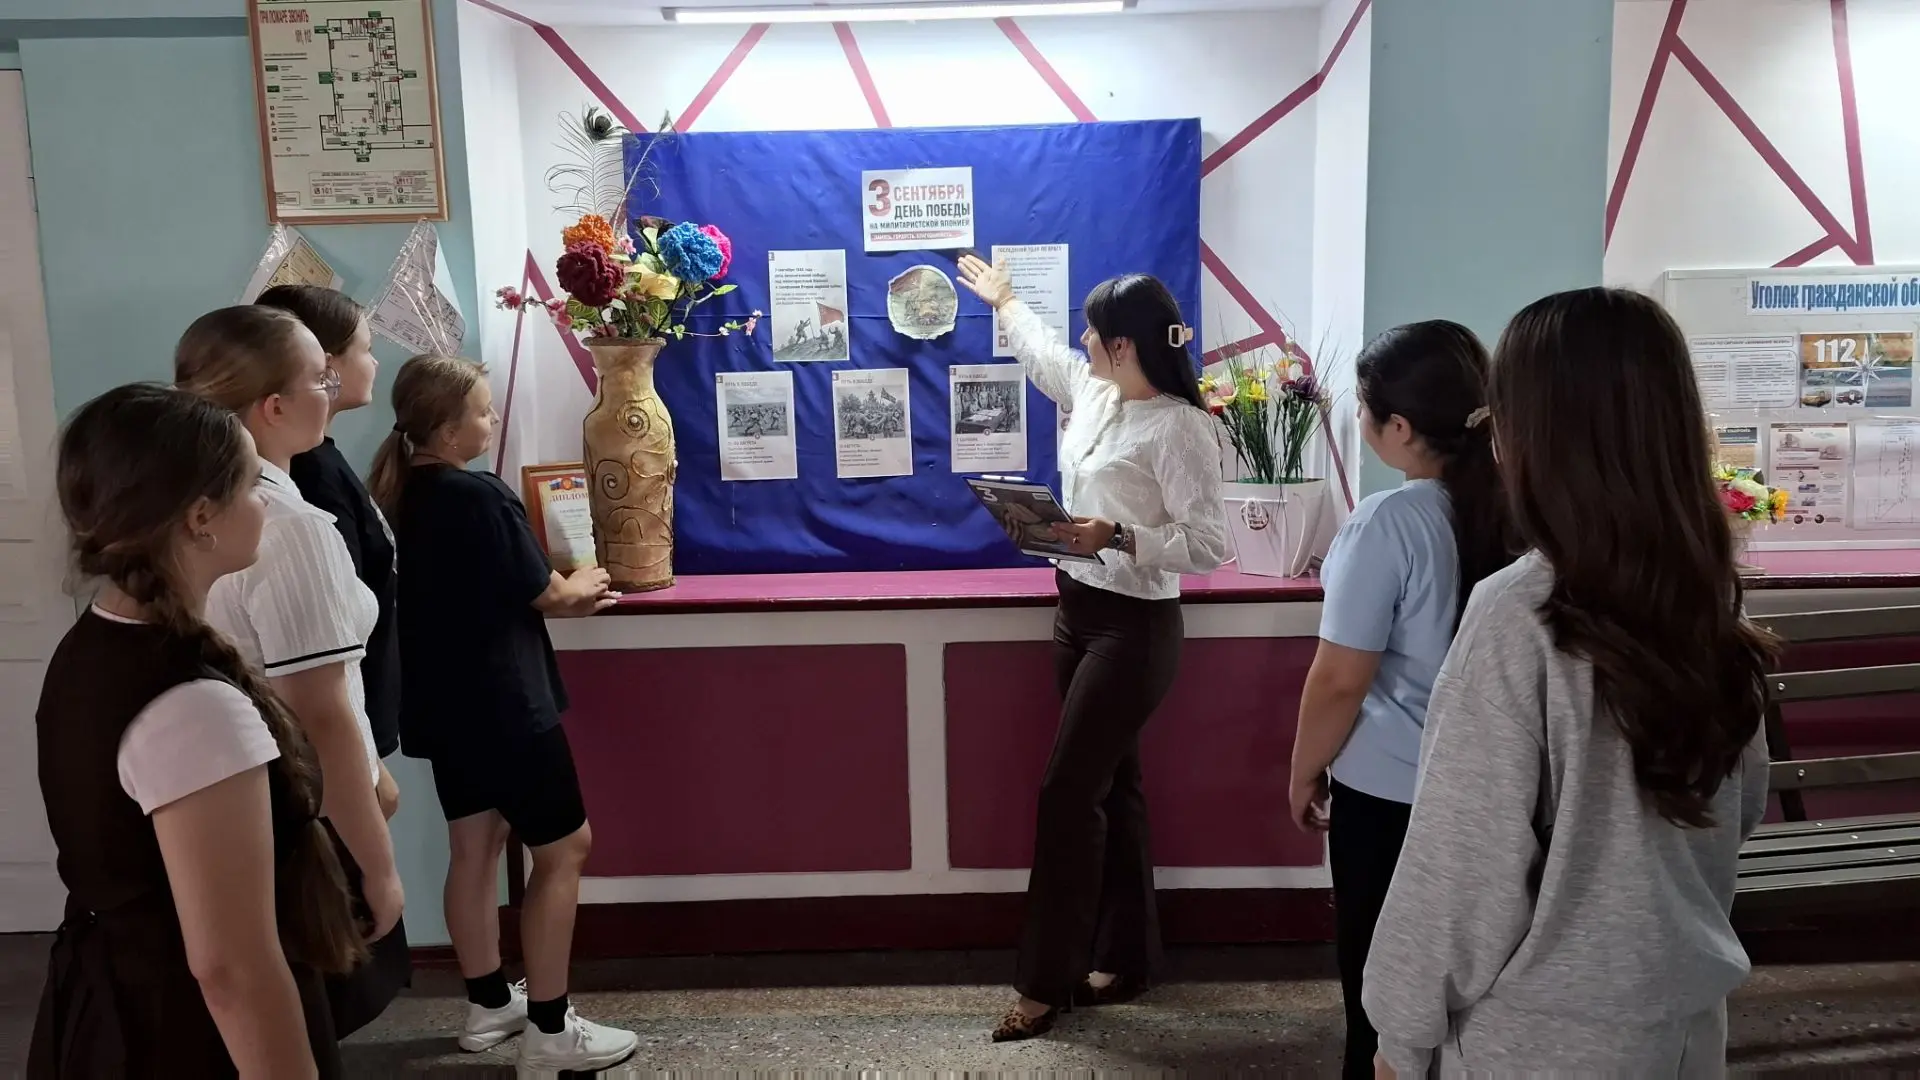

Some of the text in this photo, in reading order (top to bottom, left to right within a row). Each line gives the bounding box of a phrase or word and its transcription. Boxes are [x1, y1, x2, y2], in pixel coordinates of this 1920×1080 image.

[259, 9, 309, 23] ПРИ ПОЖАРЕ ЗВОНИТЬ
[868, 178, 965, 217] 3 СЕНТЯБРЯ
[894, 202, 970, 220] ДЕНЬ ПОБЕДЫ
[880, 219, 939, 229] МИЛИТАРИСТСКОЙ
[940, 218, 970, 227] ЯПОНИЕЙ
[1751, 276, 1920, 311] Уголок гражданской об
[1814, 338, 1857, 363] 112
[550, 492, 589, 502] ДИПЛОМ
[975, 486, 998, 503] 3
